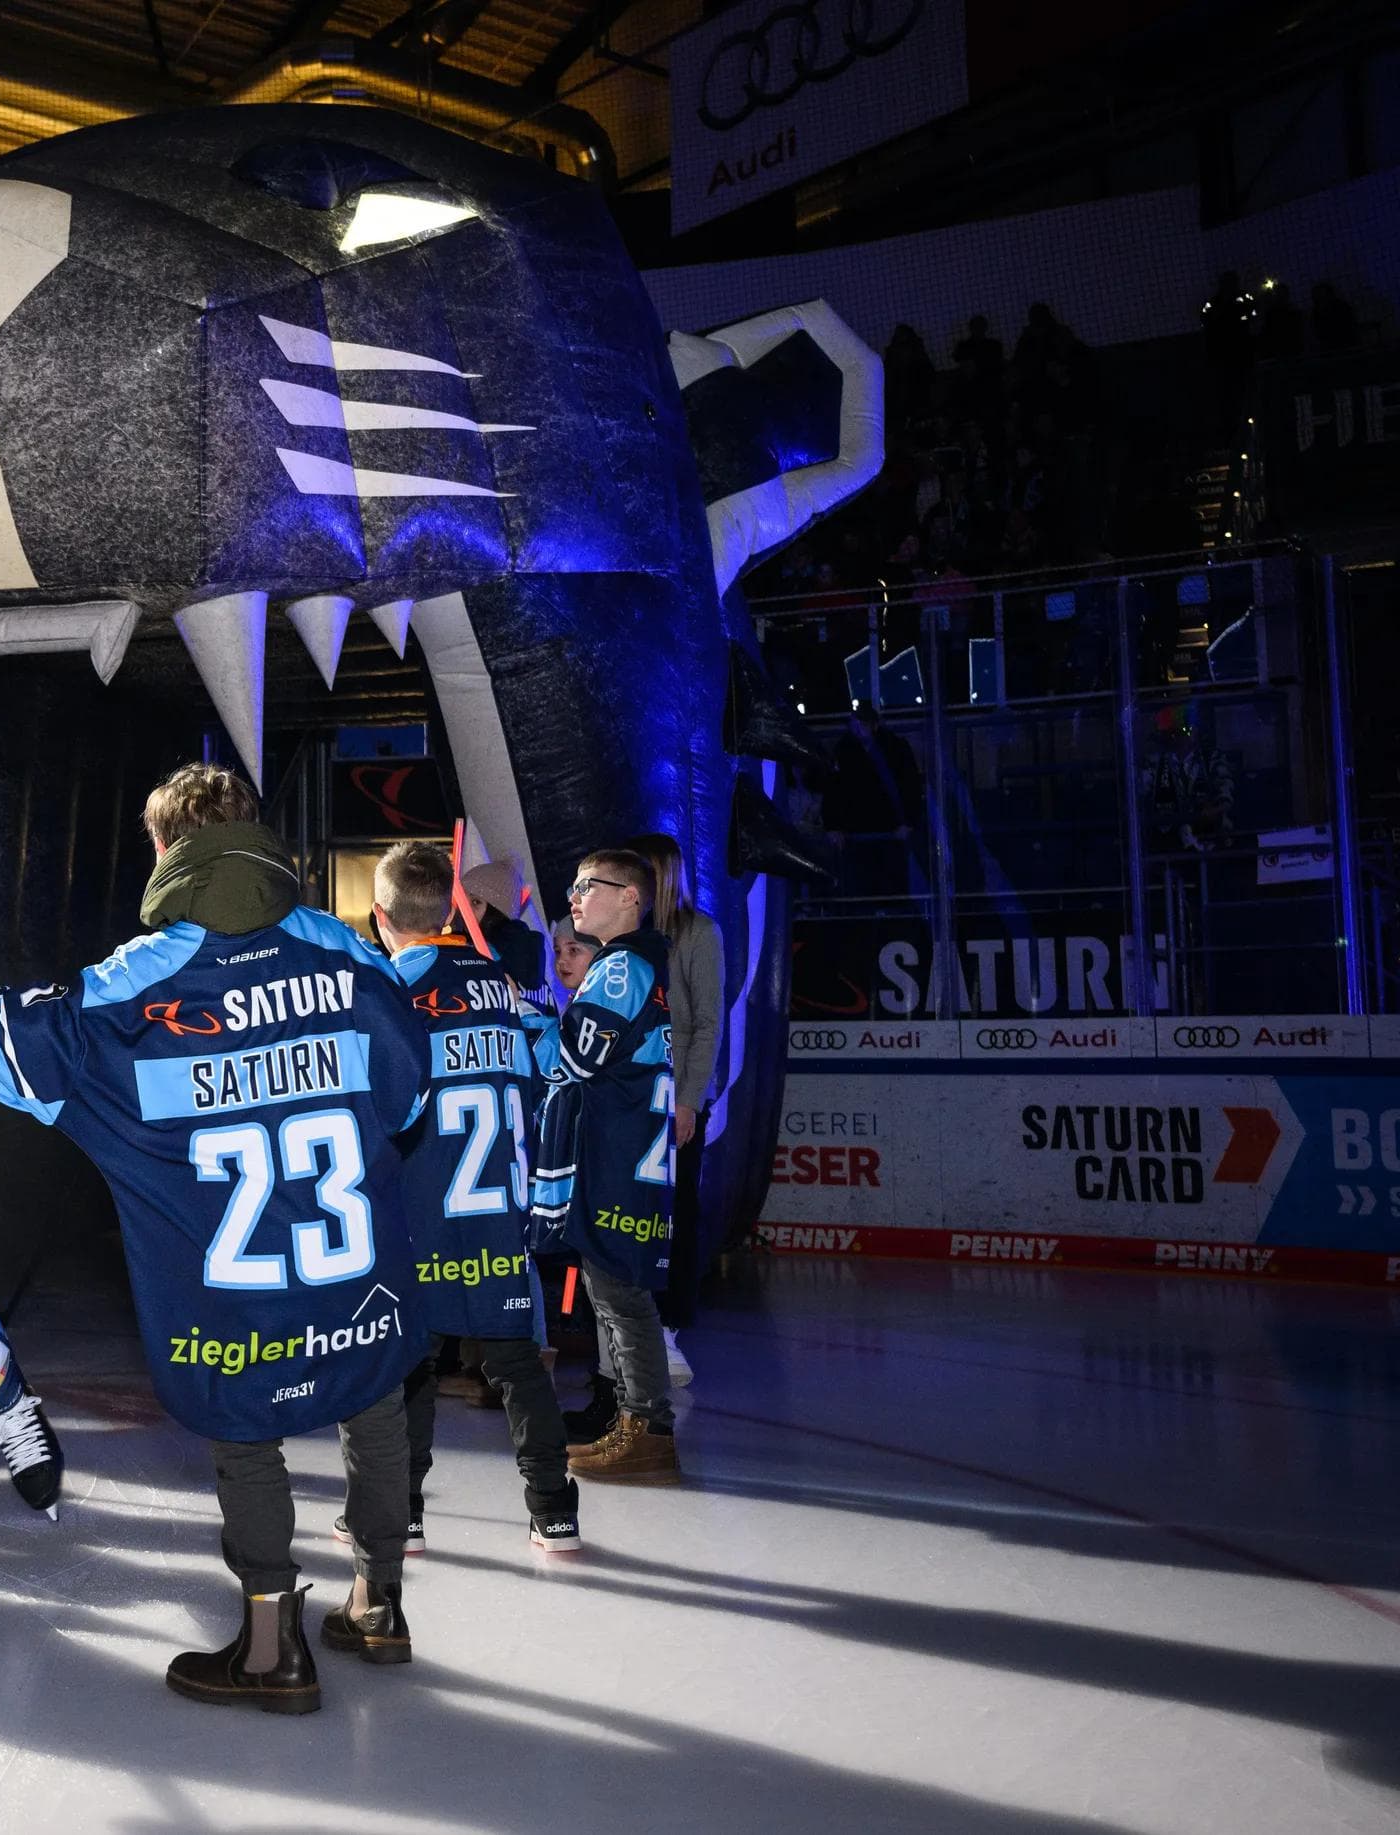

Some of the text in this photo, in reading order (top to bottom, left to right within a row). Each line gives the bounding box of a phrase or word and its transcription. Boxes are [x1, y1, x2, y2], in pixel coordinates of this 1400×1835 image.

[707, 126, 796, 196] Audi
[858, 1031, 921, 1049] Audi
[1050, 1029, 1116, 1047] Audi
[1253, 1027, 1327, 1046] Audi
[191, 1037, 342, 1110] SATURN
[777, 1110, 878, 1137] GEREI
[1022, 1105, 1202, 1152] SATURN
[189, 1108, 376, 1290] 23
[1075, 1156, 1203, 1203] CARD
[170, 1314, 391, 1375] zieglerhaus
[546, 1522, 574, 1533] adidas
